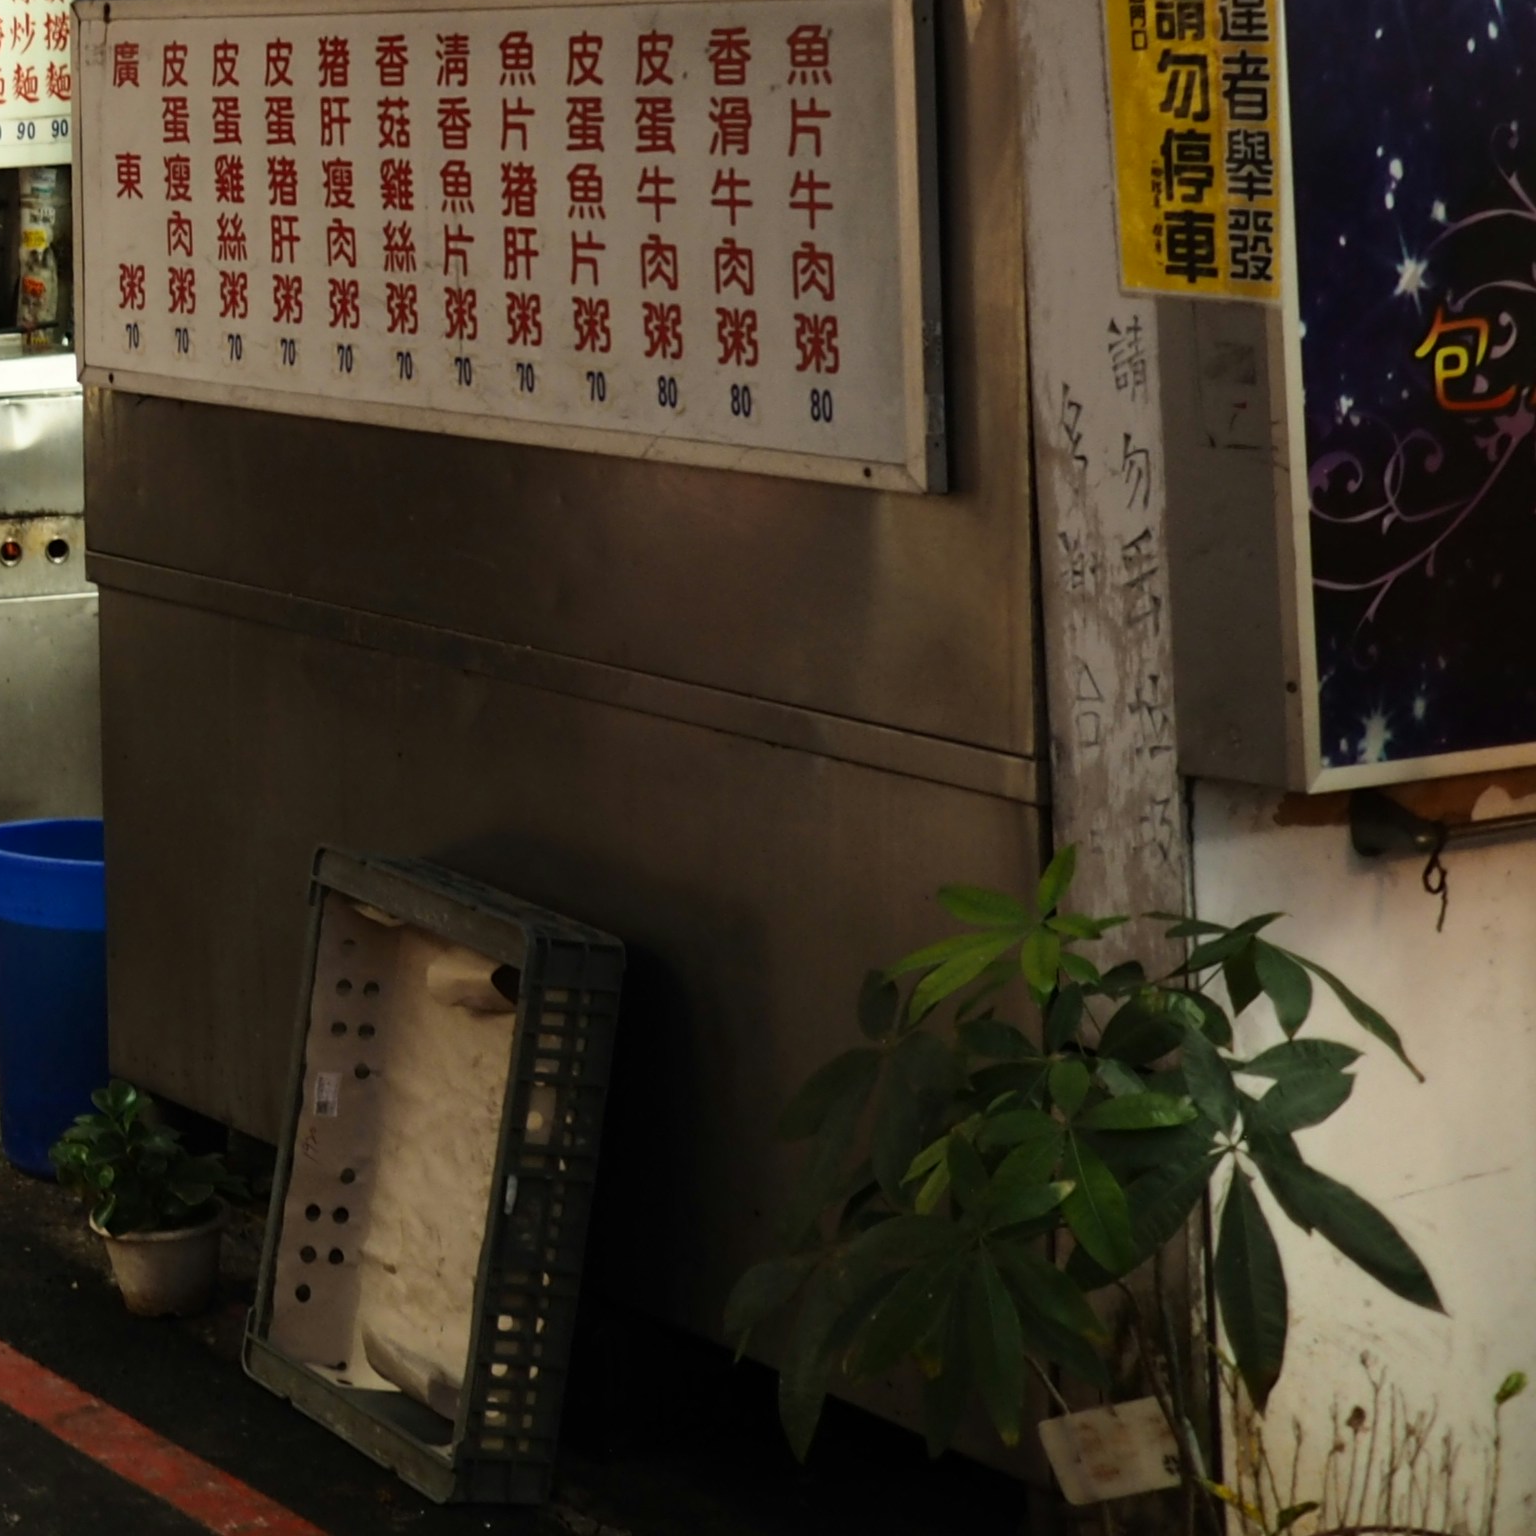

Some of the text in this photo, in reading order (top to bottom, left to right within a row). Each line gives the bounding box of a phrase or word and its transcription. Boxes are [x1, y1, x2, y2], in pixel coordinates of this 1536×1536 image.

[17, 122, 36, 140] 90
[51, 119, 69, 138] 90
[125, 323, 833, 423] 70 70 70 70 70 70 70 70 70 80 80 80
